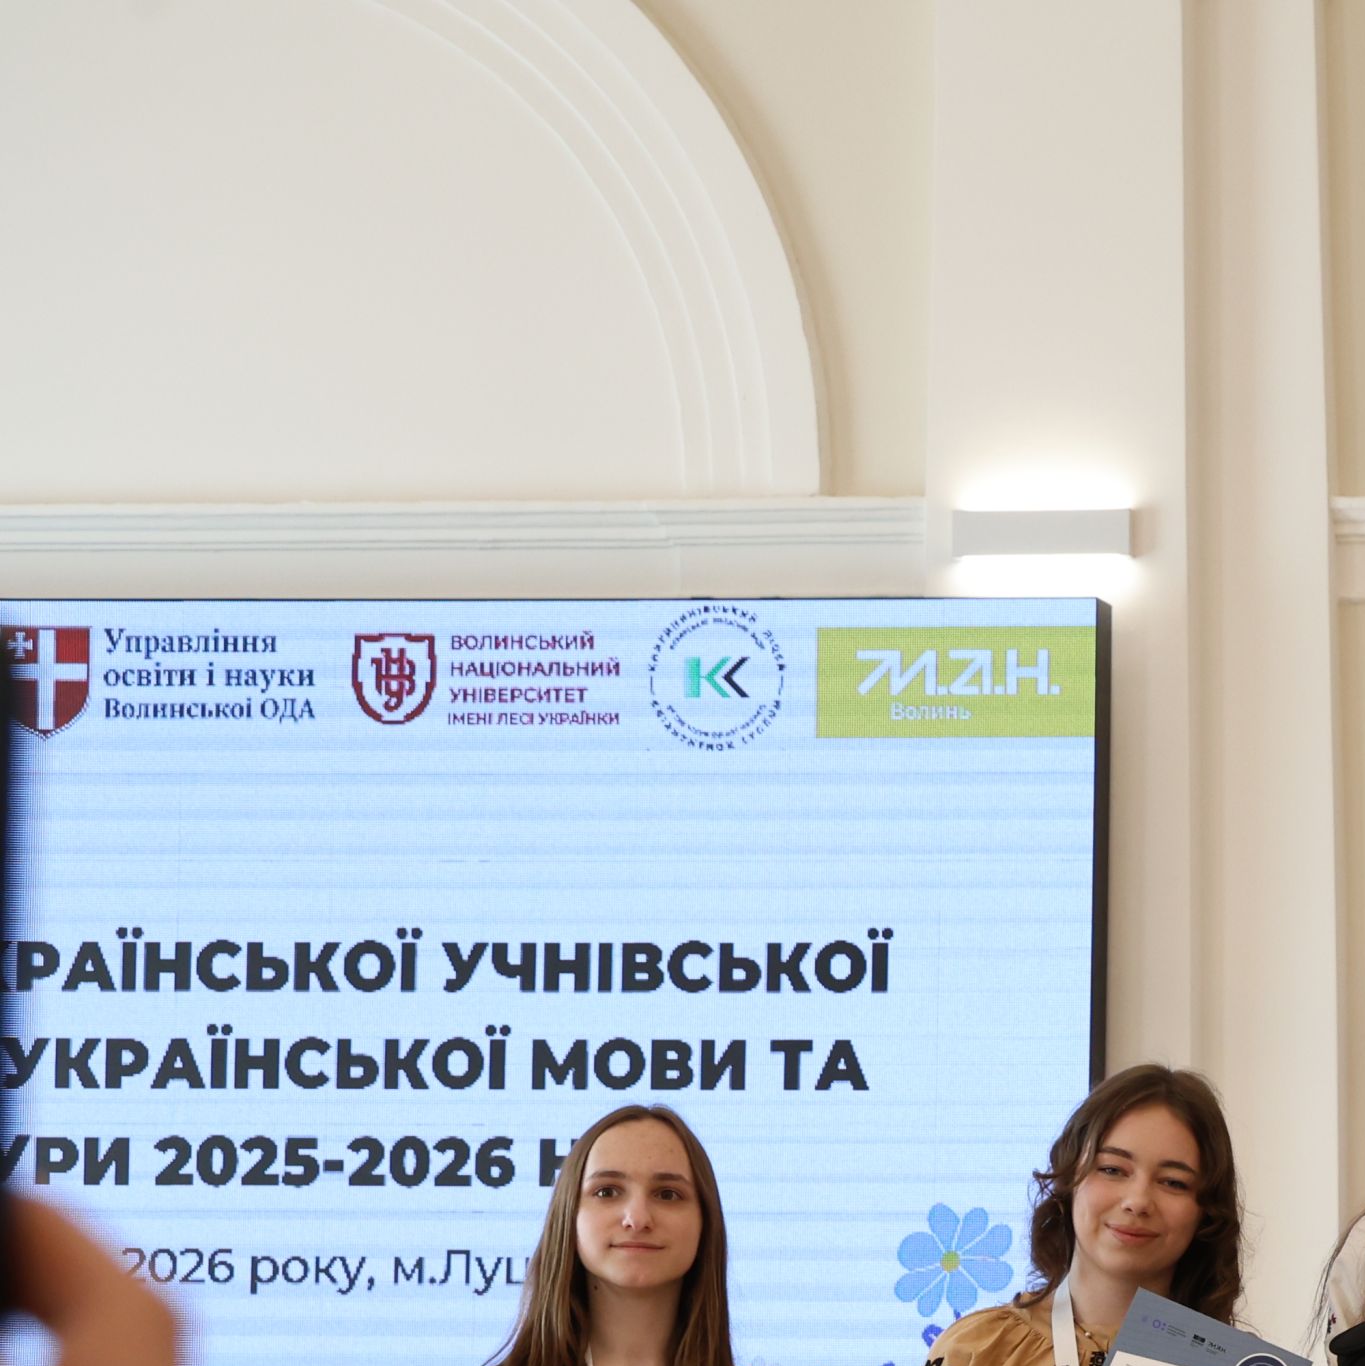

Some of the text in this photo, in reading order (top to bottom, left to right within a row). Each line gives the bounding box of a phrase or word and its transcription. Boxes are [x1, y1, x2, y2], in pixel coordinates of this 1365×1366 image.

[104, 628, 278, 659] Управління
[451, 631, 595, 651] ВОЛИНСЬКИЙ
[103, 665, 315, 695] освіти і науки
[450, 657, 621, 679] НАЦІОНАЛЬНИЙ
[449, 687, 589, 704] УНІВЕРСИТЕТ
[260, 699, 316, 724] ОДА
[448, 709, 621, 726] ІМЕНІ ЛЕСІ УКРАЇНКИ
[891, 702, 973, 721] Волинь
[0, 927, 894, 993] РАЇНСЬКОЇ УЧНІВСЬКОЇ
[1, 1024, 870, 1091] УКРАЇНСЬКОЇ МОВИ ТА
[153, 1134, 516, 1189] 2025-2026
[121, 1247, 235, 1283] 2026
[250, 1255, 376, 1295] року,
